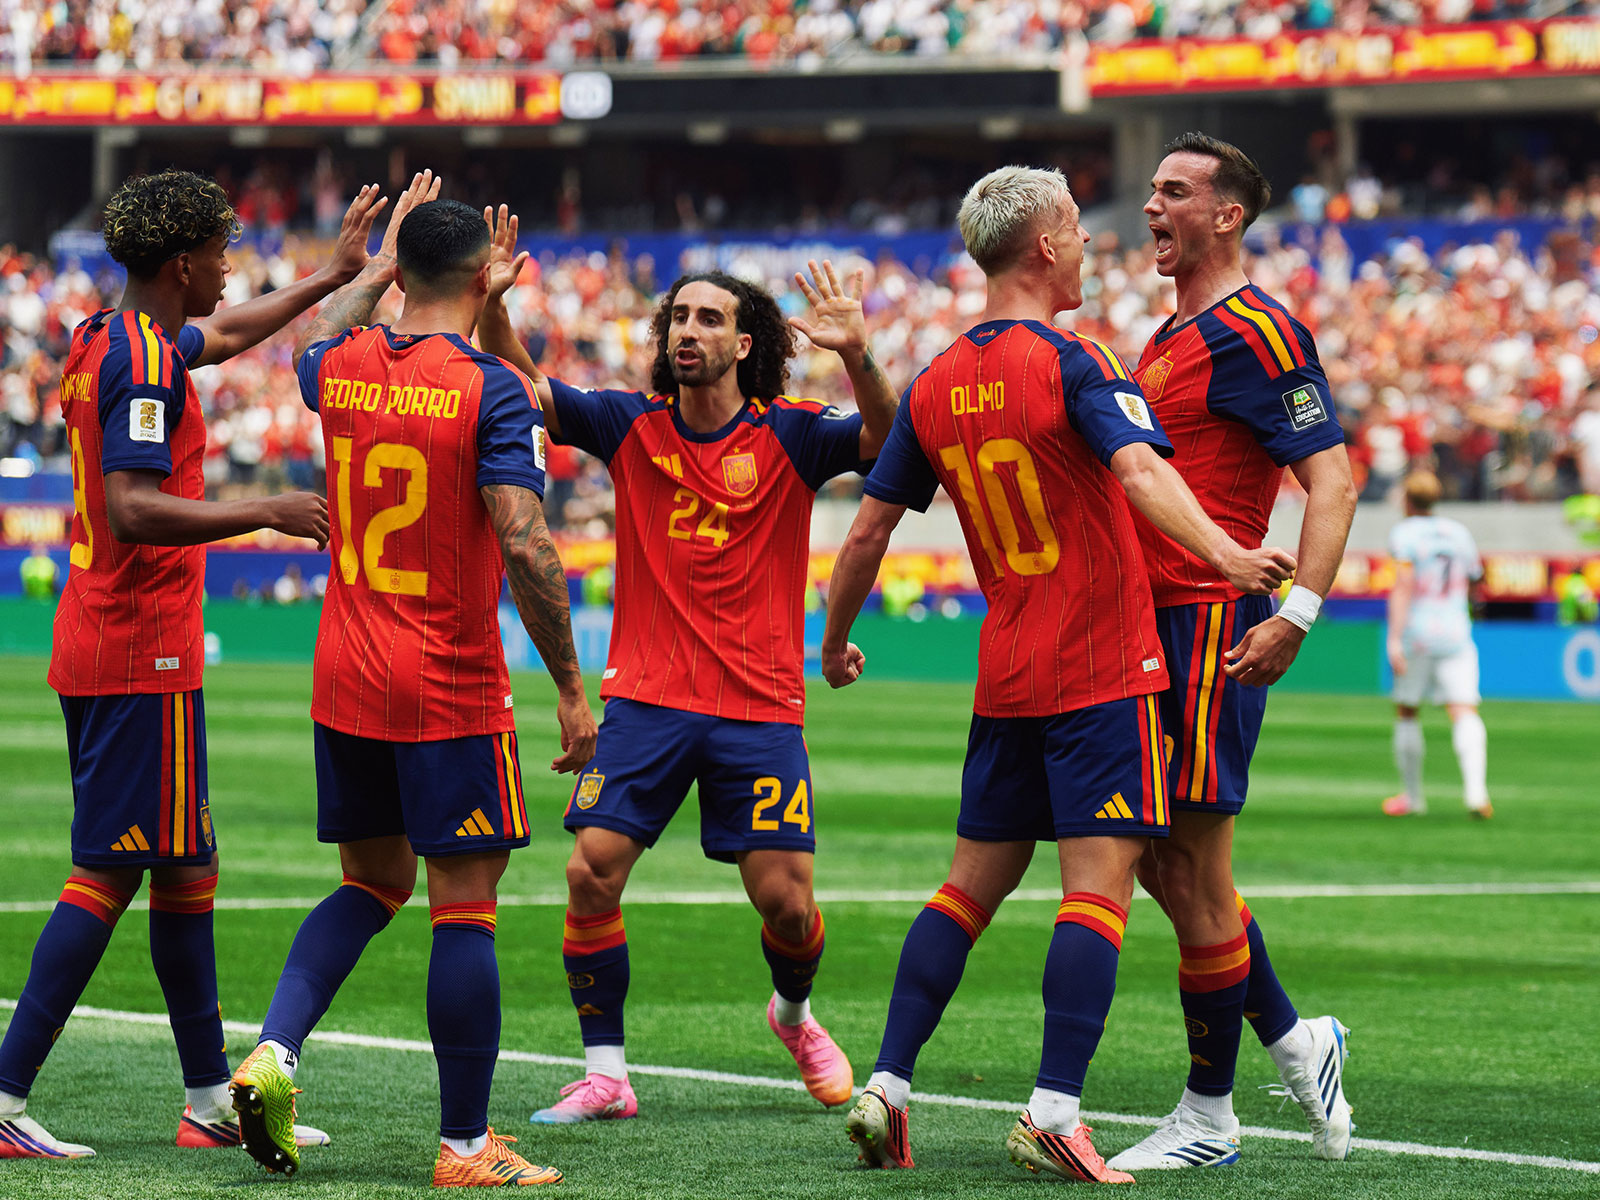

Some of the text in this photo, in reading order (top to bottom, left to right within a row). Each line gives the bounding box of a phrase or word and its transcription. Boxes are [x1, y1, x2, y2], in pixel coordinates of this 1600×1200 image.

[323, 377, 461, 419] PEDRO PORRO
[950, 380, 1005, 416] OLMO
[66, 423, 94, 570] 9
[332, 435, 429, 597] 12
[667, 487, 730, 548] 24
[938, 438, 1060, 577] 10
[751, 776, 811, 834] 24
